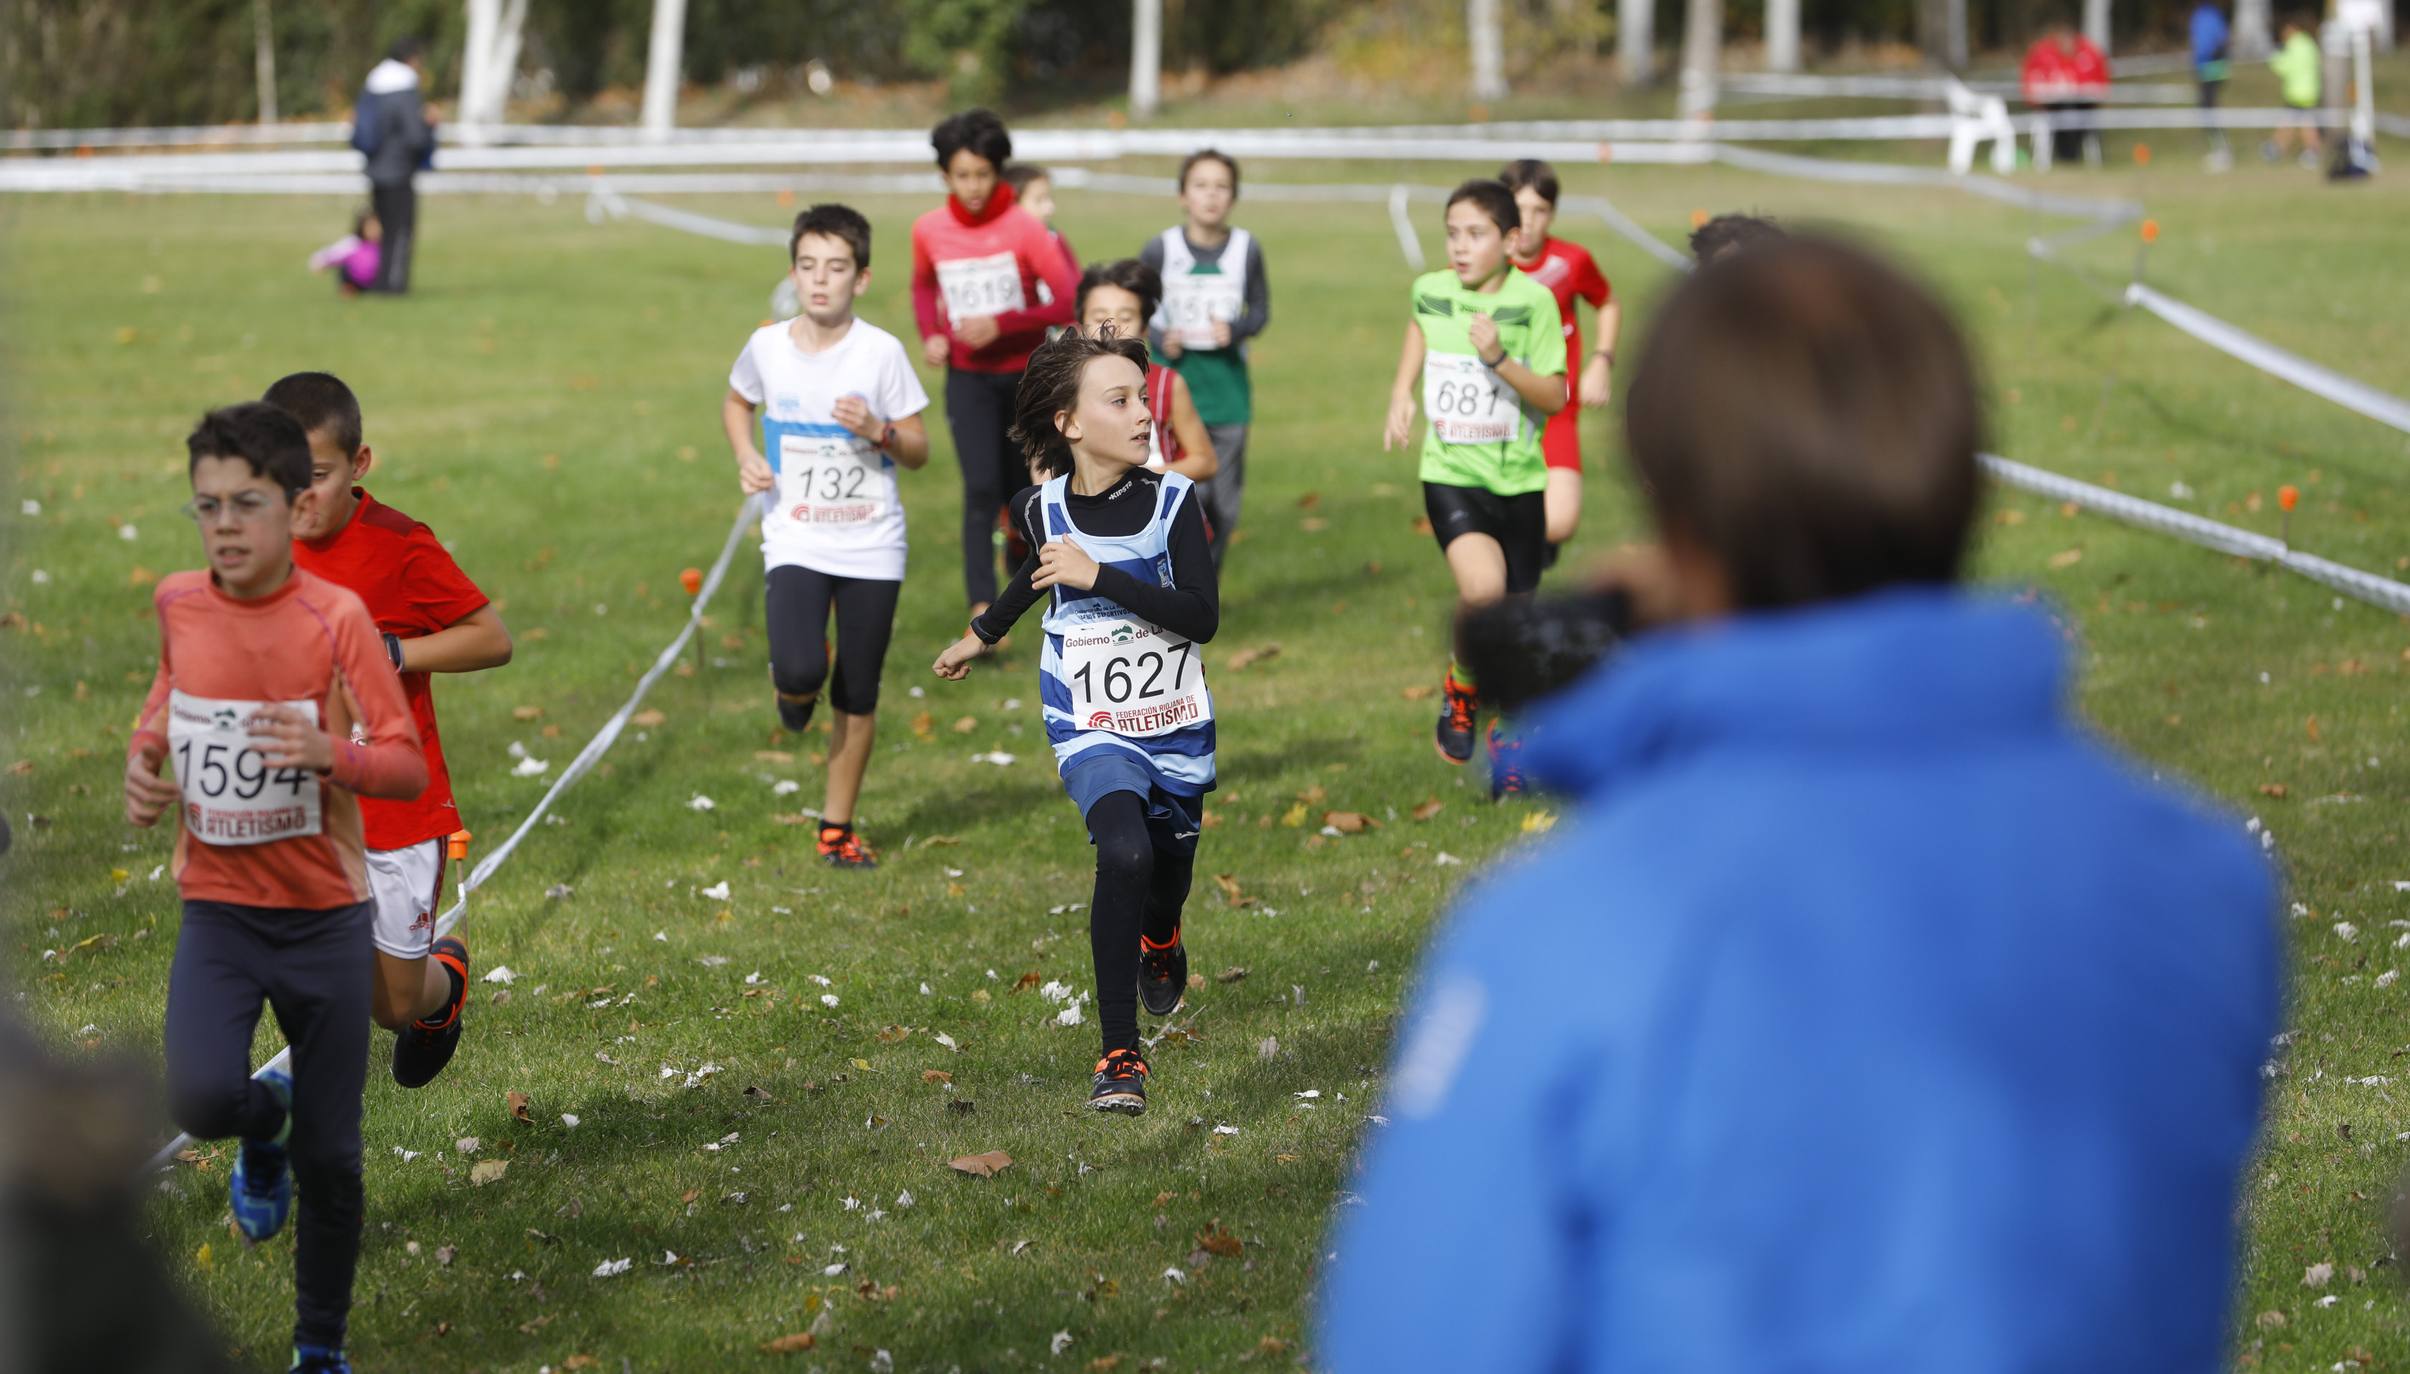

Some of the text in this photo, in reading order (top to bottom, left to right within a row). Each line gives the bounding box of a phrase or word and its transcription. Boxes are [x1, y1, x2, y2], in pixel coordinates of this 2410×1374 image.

[949, 273, 1017, 309] 1619
[1438, 380, 1501, 416] 681
[800, 465, 866, 500] 132
[1065, 634, 1110, 648] Gobierno
[1136, 628, 1149, 639] de
[1074, 640, 1192, 704] 1627
[1115, 694, 1195, 719] FEDERACIÓN RIOJANA DE
[1119, 702, 1198, 732] ATLETISMO
[178, 740, 309, 801] 1594
